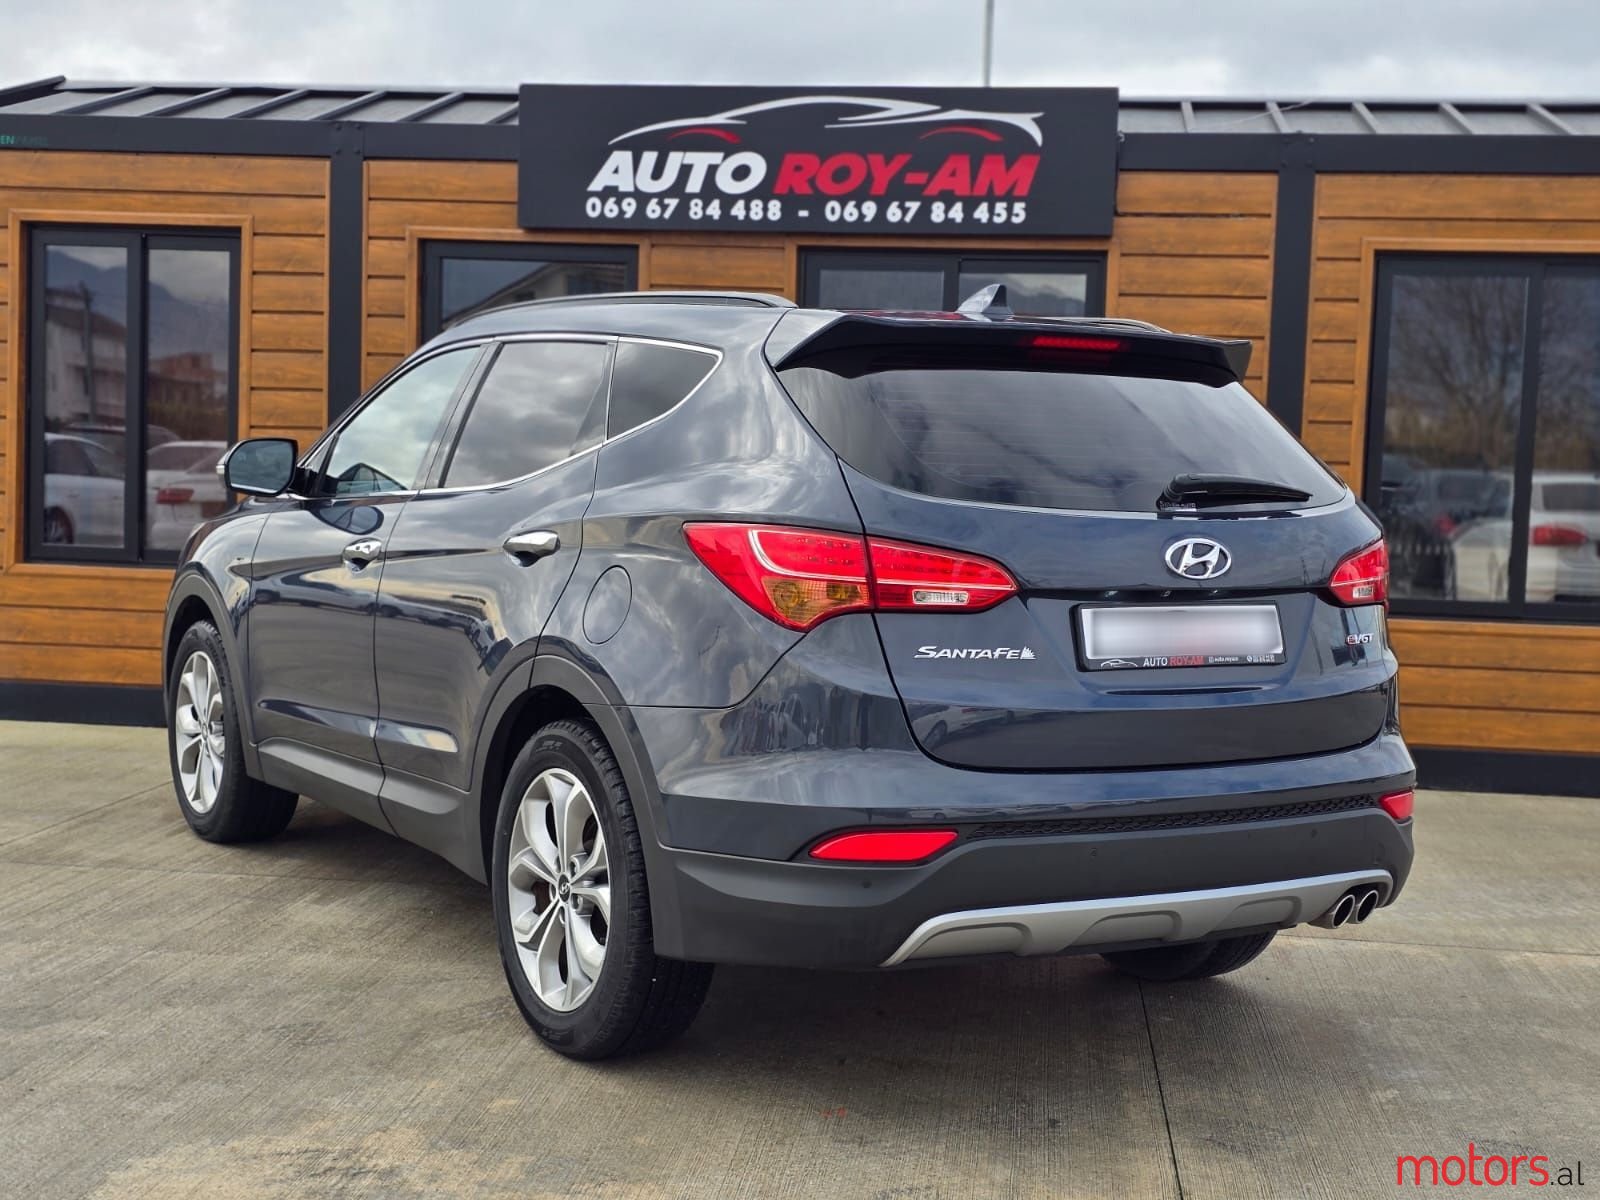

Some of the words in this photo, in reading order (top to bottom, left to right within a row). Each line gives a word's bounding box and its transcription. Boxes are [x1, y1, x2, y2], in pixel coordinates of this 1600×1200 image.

[586, 150, 767, 195] AUTO
[773, 153, 1040, 197] ROY-AM
[585, 197, 637, 219] 069
[646, 198, 680, 220] 67
[689, 199, 722, 220] 84
[730, 199, 782, 221] 488
[798, 209, 810, 218] -
[825, 200, 877, 222] 069
[886, 201, 921, 223] 67
[930, 201, 964, 223] 84
[973, 202, 1026, 224] 455
[1143, 656, 1168, 667] AUTO
[1170, 655, 1205, 667] ROY-AM
